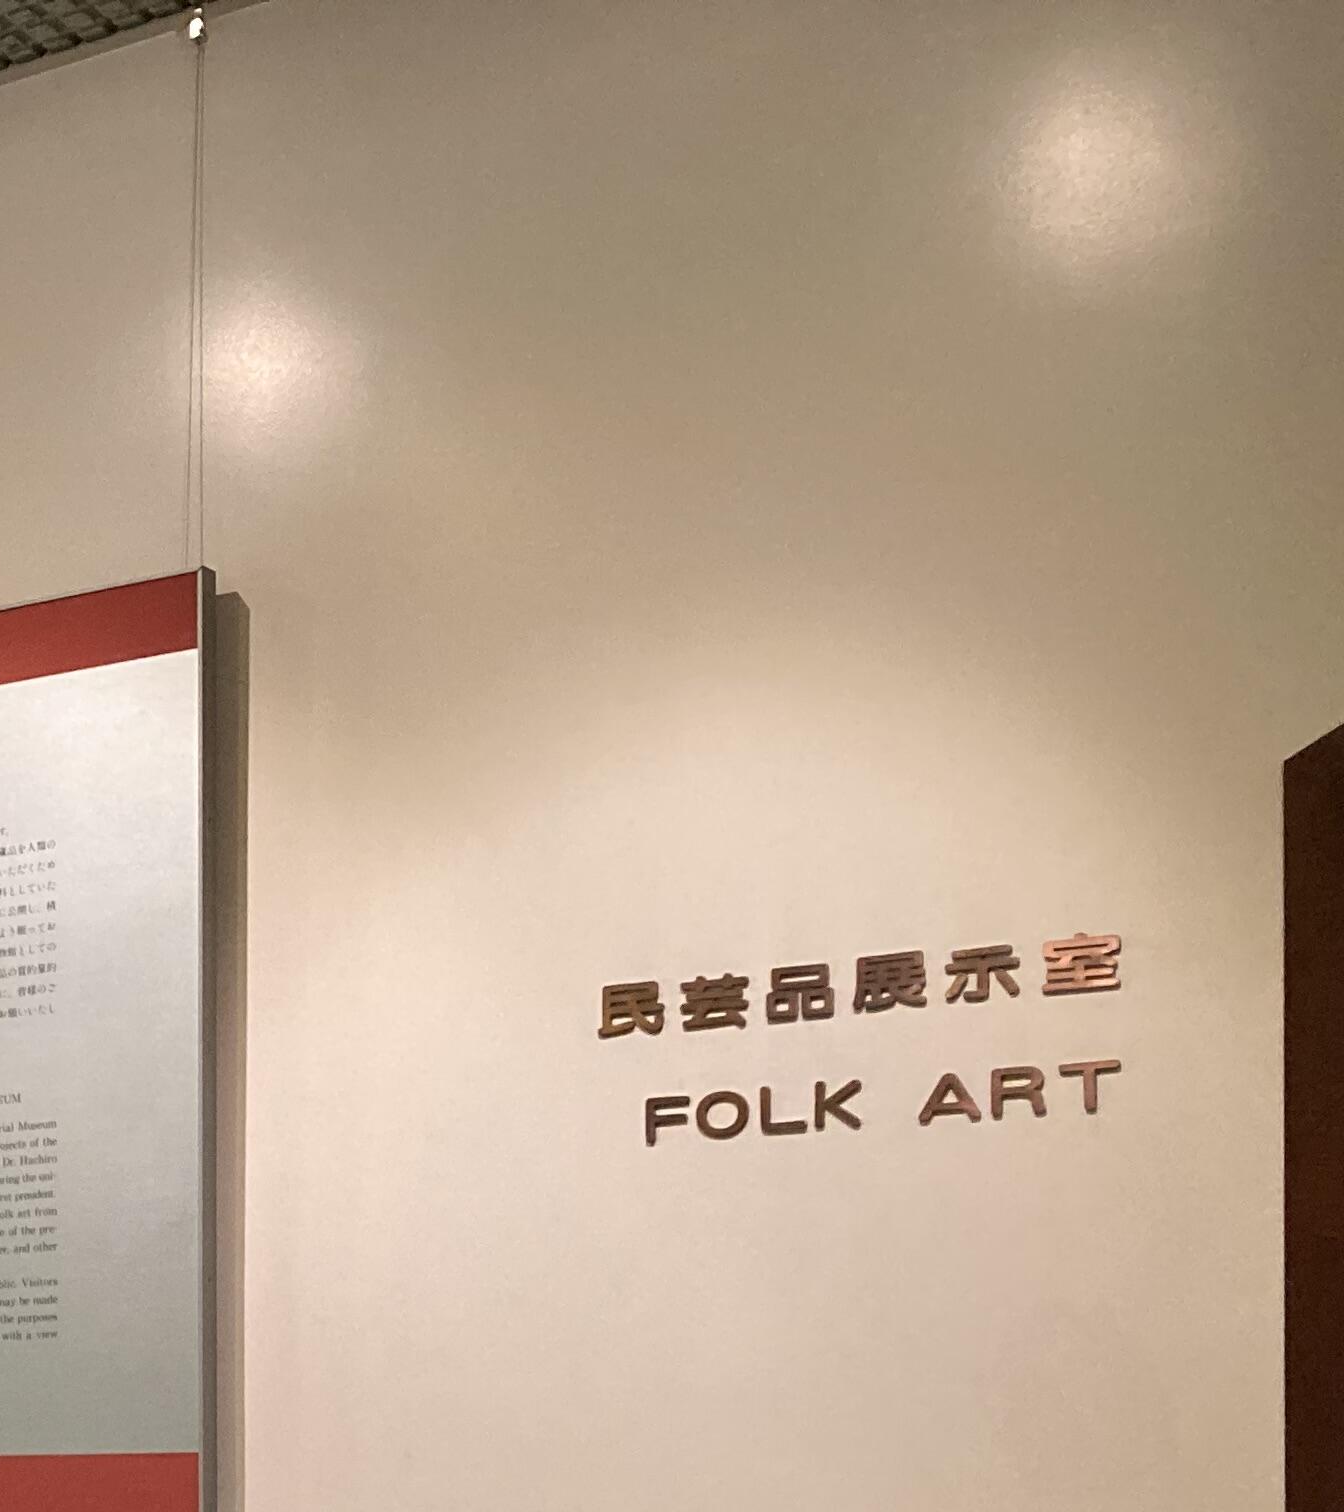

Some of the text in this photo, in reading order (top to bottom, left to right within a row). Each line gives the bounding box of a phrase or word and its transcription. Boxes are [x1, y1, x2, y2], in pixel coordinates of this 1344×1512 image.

[598, 932, 1122, 1039] 民芸品展示室
[645, 1059, 1122, 1146] FOLK ART
[16, 1119, 57, 1132] Museum
[42, 1137, 57, 1148] the
[21, 1277, 57, 1288] Visitors
[0, 1314, 13, 1324] the
[17, 1313, 57, 1325] purposes
[1, 1330, 22, 1341] with
